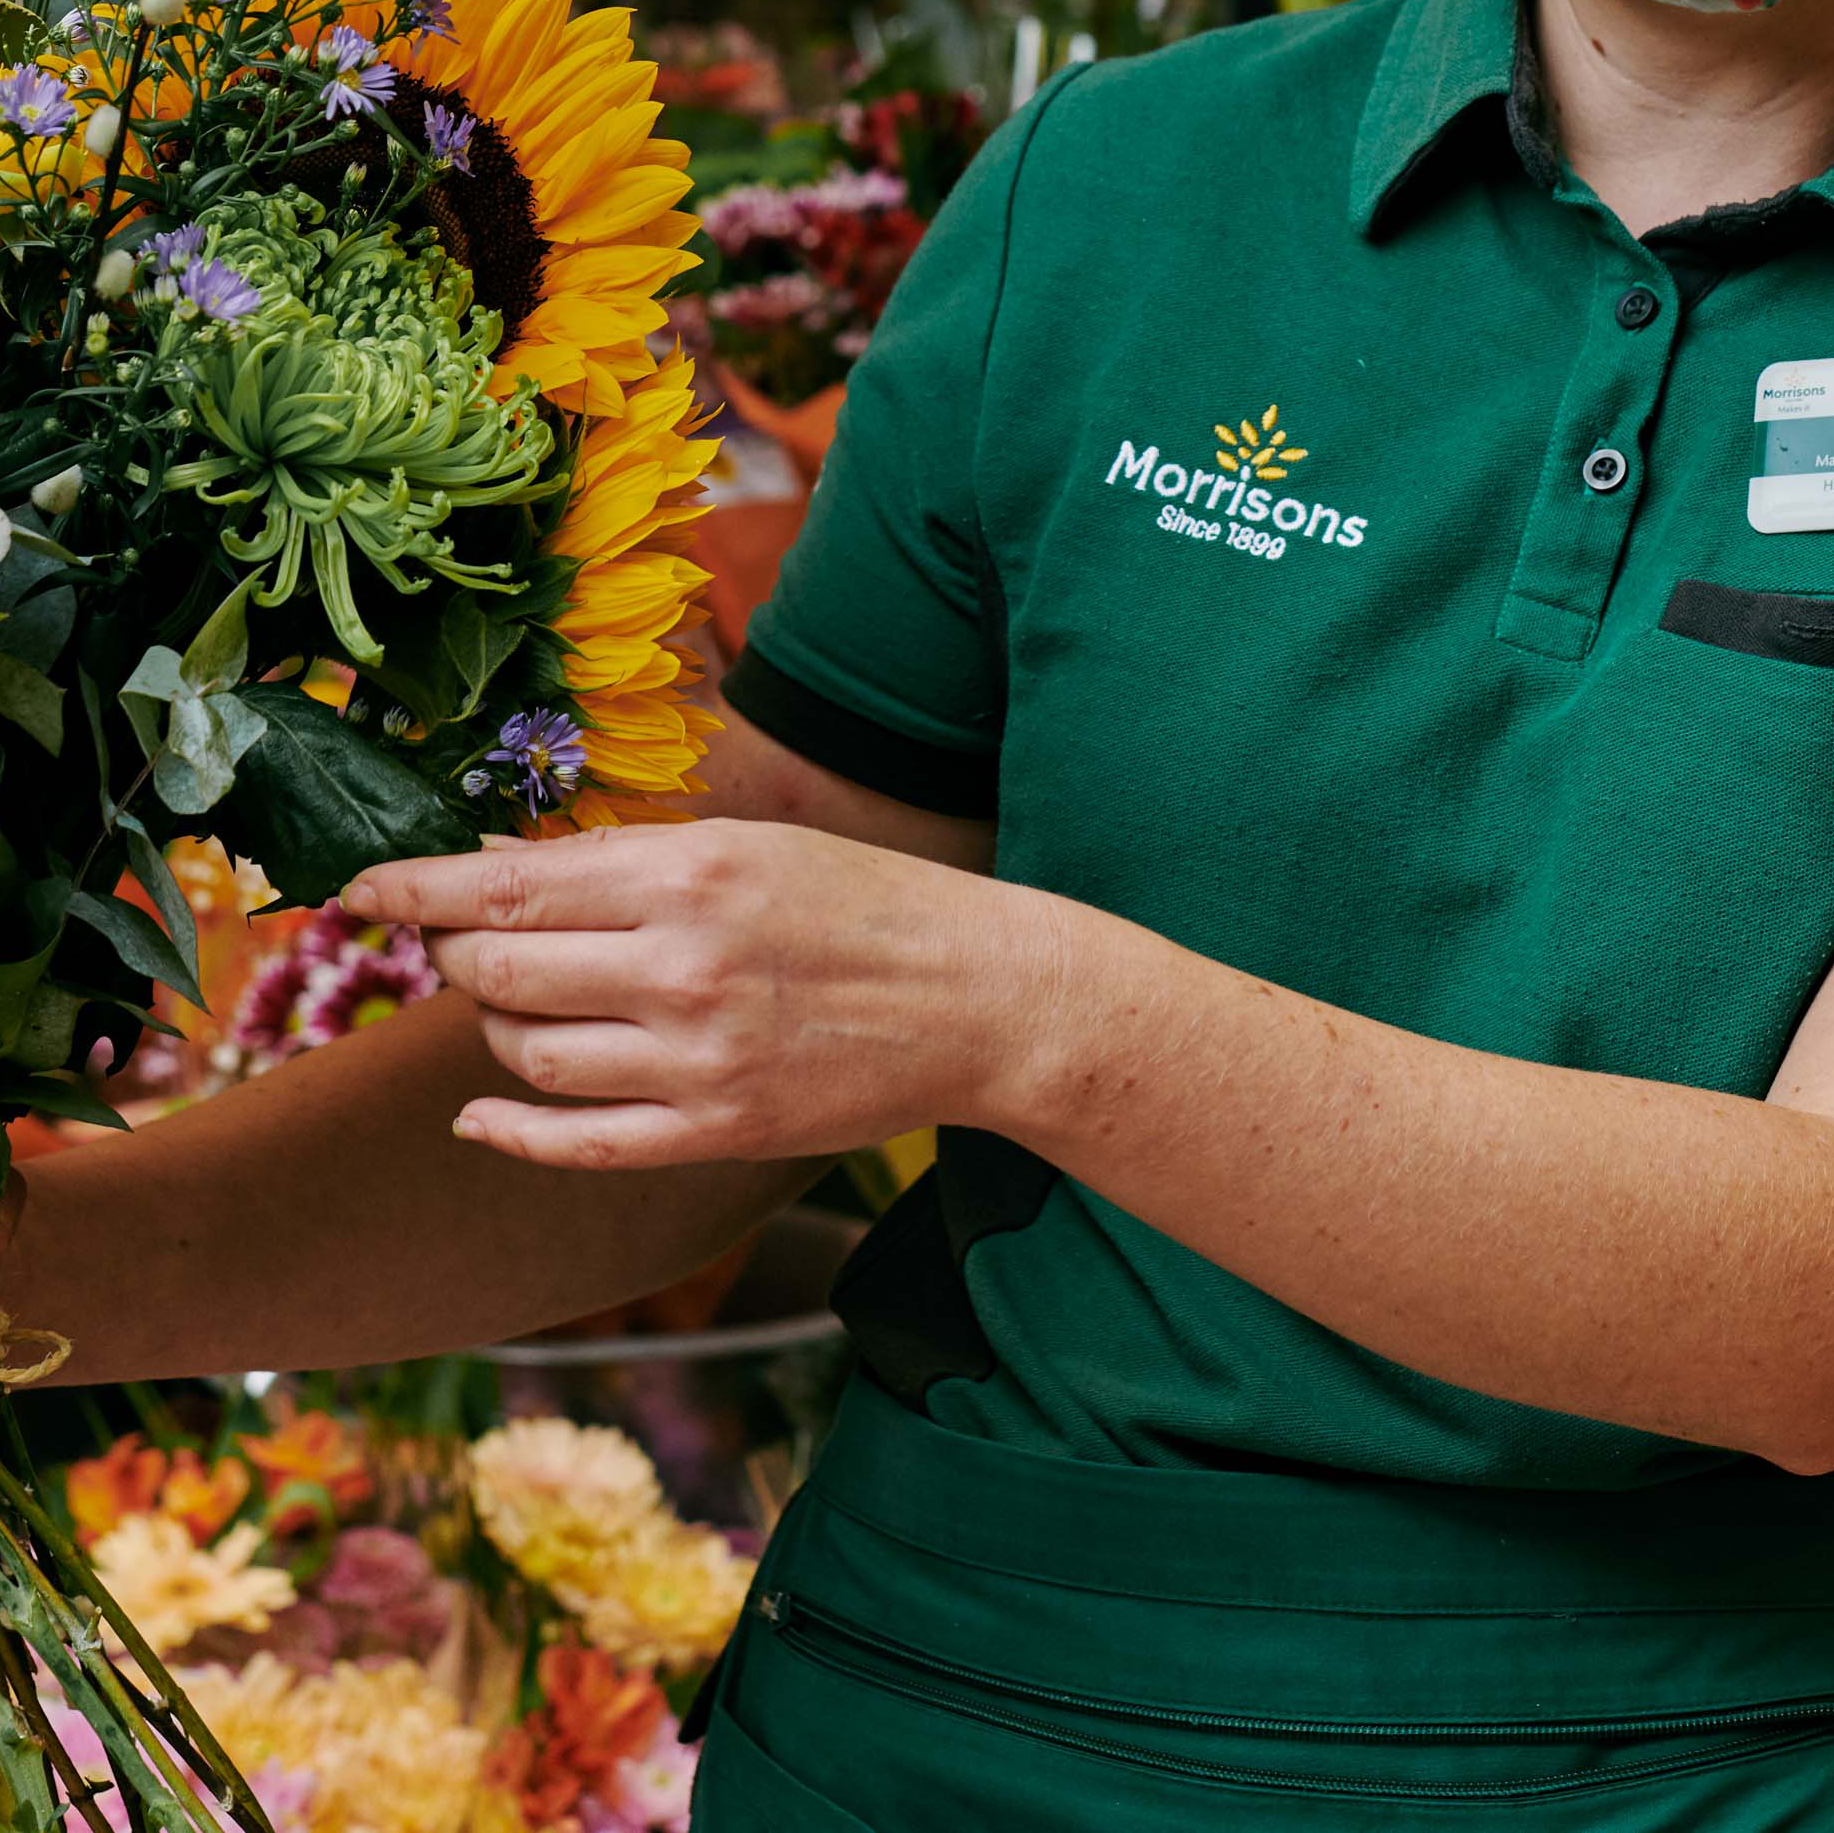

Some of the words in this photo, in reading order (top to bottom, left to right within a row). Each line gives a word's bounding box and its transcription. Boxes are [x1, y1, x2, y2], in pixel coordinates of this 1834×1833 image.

[1763, 385, 1826, 400] Morrisons
[1104, 440, 1370, 548] Morrisons
[1156, 504, 1222, 542] Since
[1226, 522, 1287, 560] 1899
